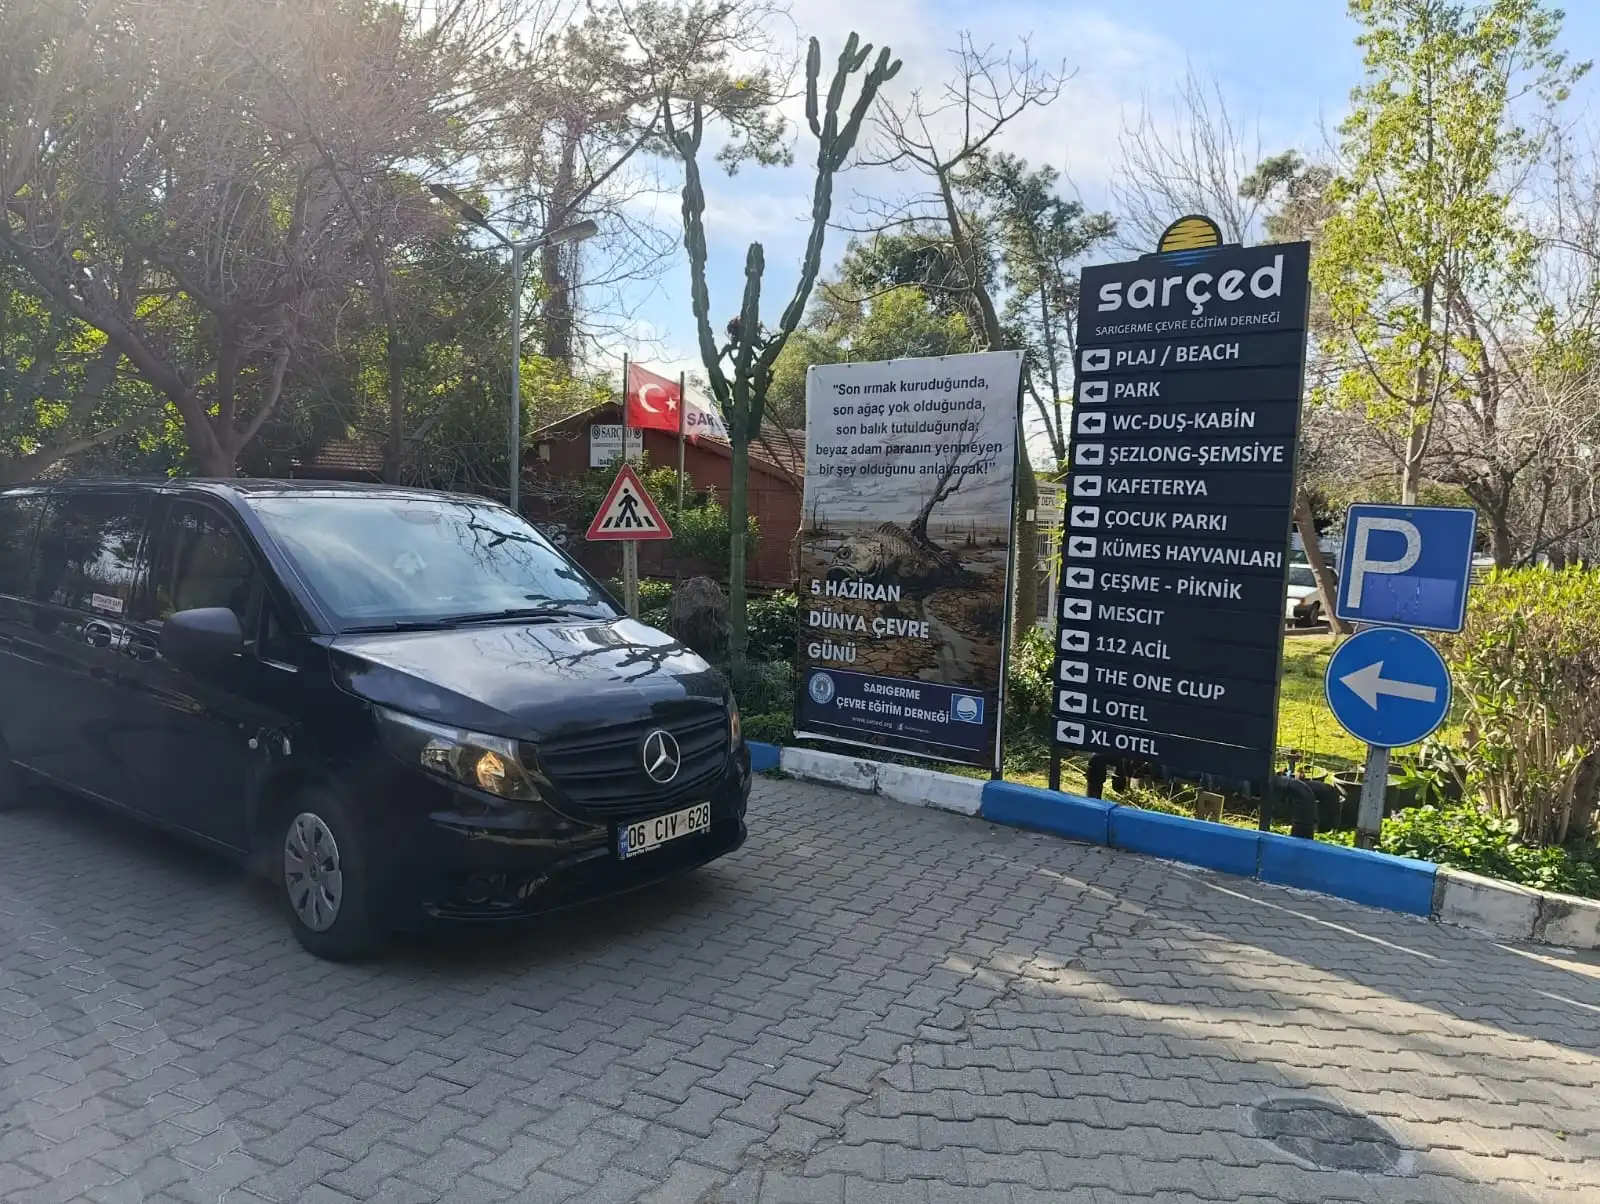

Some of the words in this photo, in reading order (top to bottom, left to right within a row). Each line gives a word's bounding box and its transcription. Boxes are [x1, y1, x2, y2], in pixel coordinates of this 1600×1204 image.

[1098, 254, 1284, 315] sarçed
[1095, 322, 1153, 336] SARIGERME
[1155, 319, 1187, 333] ÇEVRE
[1190, 315, 1227, 329] EĞİTİM
[1230, 311, 1280, 326] DERNEĞİ
[1116, 348, 1156, 366] PLAJ
[1160, 345, 1171, 367] /
[1176, 343, 1239, 363] BEACH
[864, 380, 897, 394] ırmak
[900, 377, 989, 393] kuruduğunda,
[1114, 381, 1161, 398] PARK
[833, 404, 854, 416] son
[857, 402, 884, 417] ağaç
[888, 400, 910, 416] yok
[913, 398, 986, 414] olduğunda,
[836, 424, 857, 435] son
[860, 421, 888, 435] balık
[1112, 407, 1256, 433] WC-DUŞ-KABİN
[816, 443, 848, 458] beyaz
[851, 443, 882, 456] adam
[885, 443, 931, 457] paranın
[935, 442, 1003, 457] yenmeyen
[1109, 441, 1284, 466] ŞEZLONG-ŞEMSİYE
[819, 463, 835, 475] bir
[836, 465, 856, 477] şey
[860, 462, 916, 477] olduğunu
[1107, 478, 1208, 496] KAFETERYA
[1104, 510, 1167, 529] ÇOCUK
[1172, 513, 1228, 531] PARKI
[1102, 538, 1161, 560] KÜMES
[1166, 544, 1282, 569] HAYVANLARI
[1346, 516, 1422, 609] P
[811, 579, 821, 596] 5
[825, 577, 901, 602] HAZİRAN
[1100, 572, 1160, 593] ÇEŞME
[1177, 575, 1243, 600] PİKNİK
[809, 607, 867, 633] DÜNYA
[872, 616, 930, 639] ÇEVRE
[1098, 604, 1165, 626] MESCIT
[807, 639, 857, 663] GÜNÜ
[1096, 636, 1127, 654] 112
[1131, 639, 1171, 660] ACİL
[863, 682, 921, 700] SARIGERME
[1095, 667, 1128, 687] THE
[1132, 673, 1172, 693] ONE
[1177, 680, 1226, 700] CLUP
[836, 696, 866, 710] ÇEVRE
[868, 699, 902, 716] EĞİTİM
[904, 707, 950, 724] DERNEĞİ
[1092, 698, 1101, 714] L
[1105, 701, 1149, 722] OTEL
[1090, 729, 1111, 747] XL
[1115, 734, 1159, 756] OTEL
[628, 825, 646, 848] 06
[655, 814, 678, 841] CIV
[688, 804, 709, 830] 628
